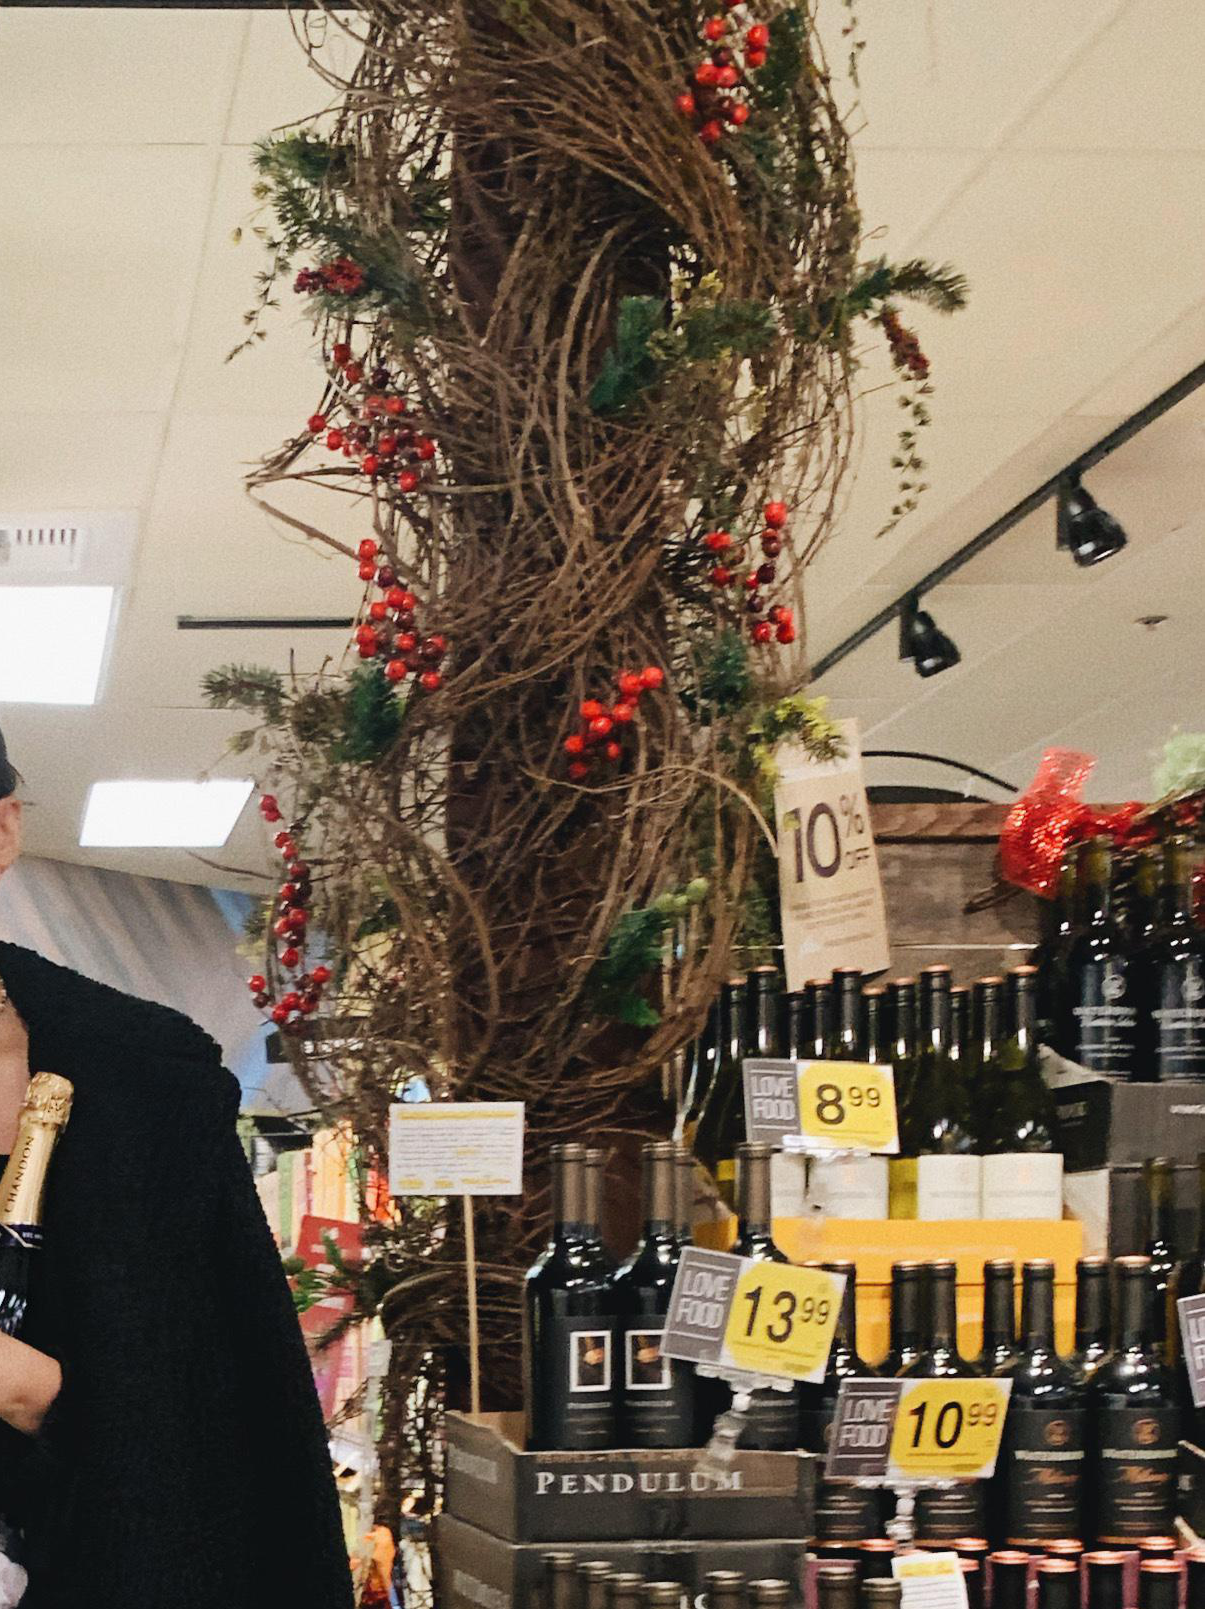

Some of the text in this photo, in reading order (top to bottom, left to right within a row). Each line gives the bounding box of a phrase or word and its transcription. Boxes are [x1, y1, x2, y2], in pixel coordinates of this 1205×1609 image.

[844, 846, 870, 870] OFF
[750, 1076, 794, 1098] LOVE
[752, 1098, 795, 1121] FOOD
[4, 1135, 34, 1213] CHANDON
[681, 1270, 732, 1302] LOVE
[675, 1297, 725, 1329] FOOD
[842, 1399, 895, 1423] LOVE
[838, 1424, 889, 1448] FOOD
[535, 1470, 744, 1496] PENDULUM
